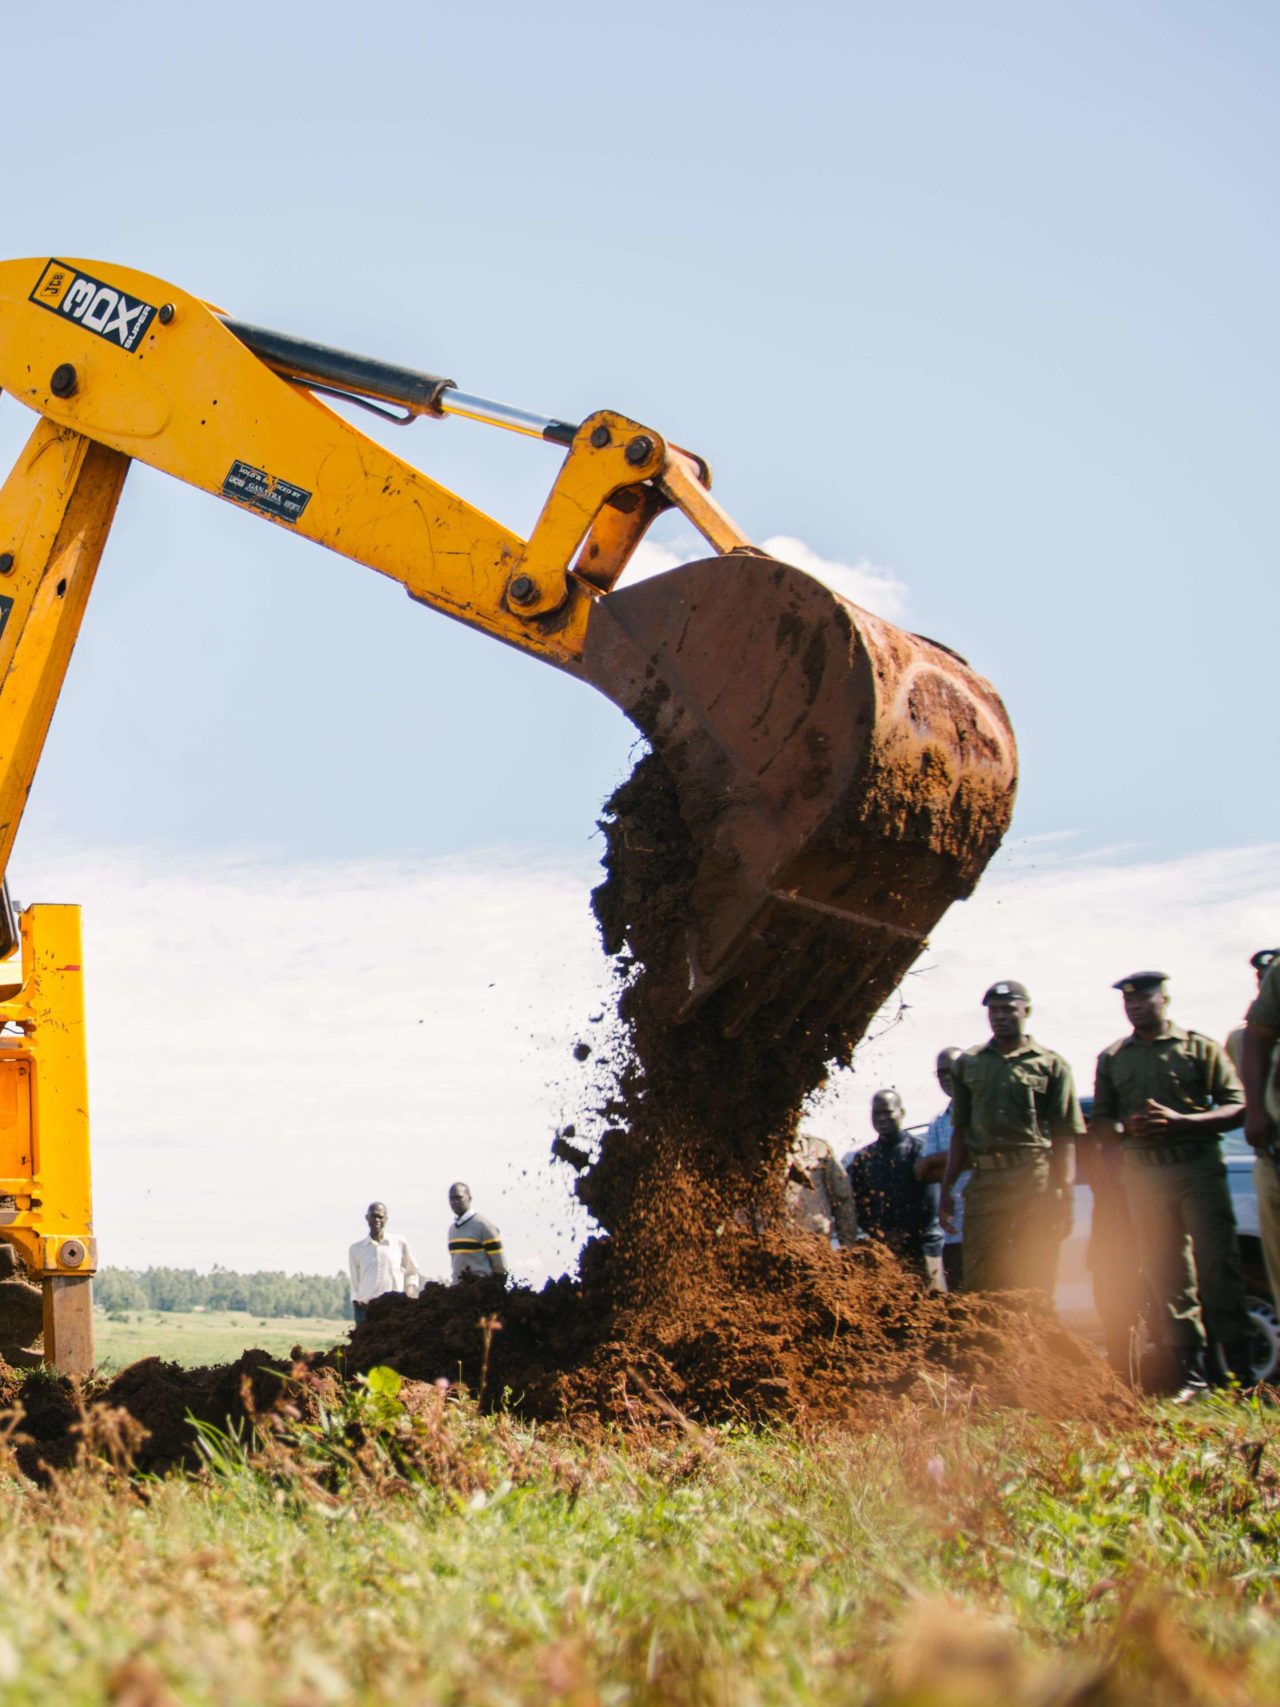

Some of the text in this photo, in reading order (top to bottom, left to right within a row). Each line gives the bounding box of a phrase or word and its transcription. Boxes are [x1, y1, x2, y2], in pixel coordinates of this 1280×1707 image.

[43, 274, 63, 295] JCB
[123, 306, 151, 349] SUPER
[292, 490, 301, 498] BY
